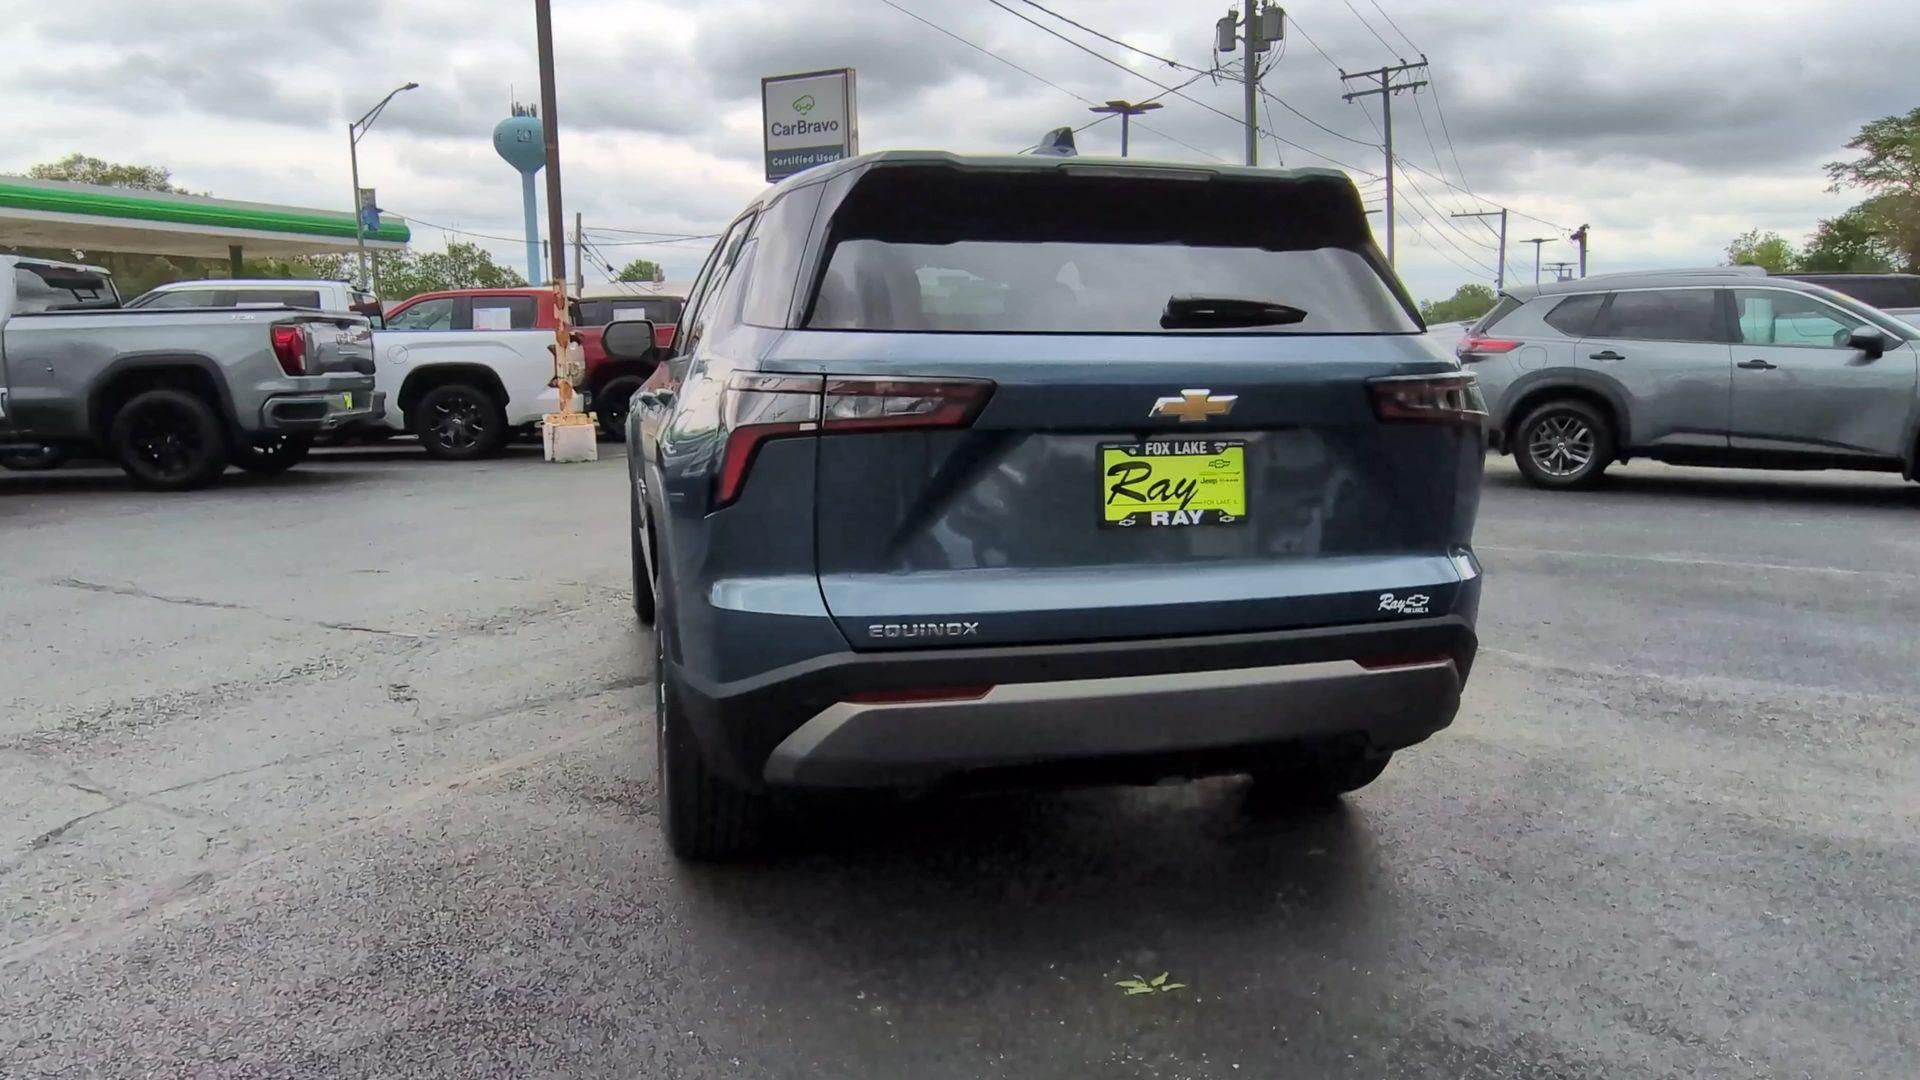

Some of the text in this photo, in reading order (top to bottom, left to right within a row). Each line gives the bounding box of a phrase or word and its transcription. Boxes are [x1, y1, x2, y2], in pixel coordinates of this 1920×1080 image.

[771, 120, 839, 137] CarBravo
[772, 153, 840, 166] Certified Used
[1145, 441, 1207, 455] FOX LAKE
[1106, 460, 1199, 511] Ray
[1151, 510, 1204, 526] RAY
[1378, 593, 1406, 613] Ray
[869, 622, 979, 637] EQUINOX
